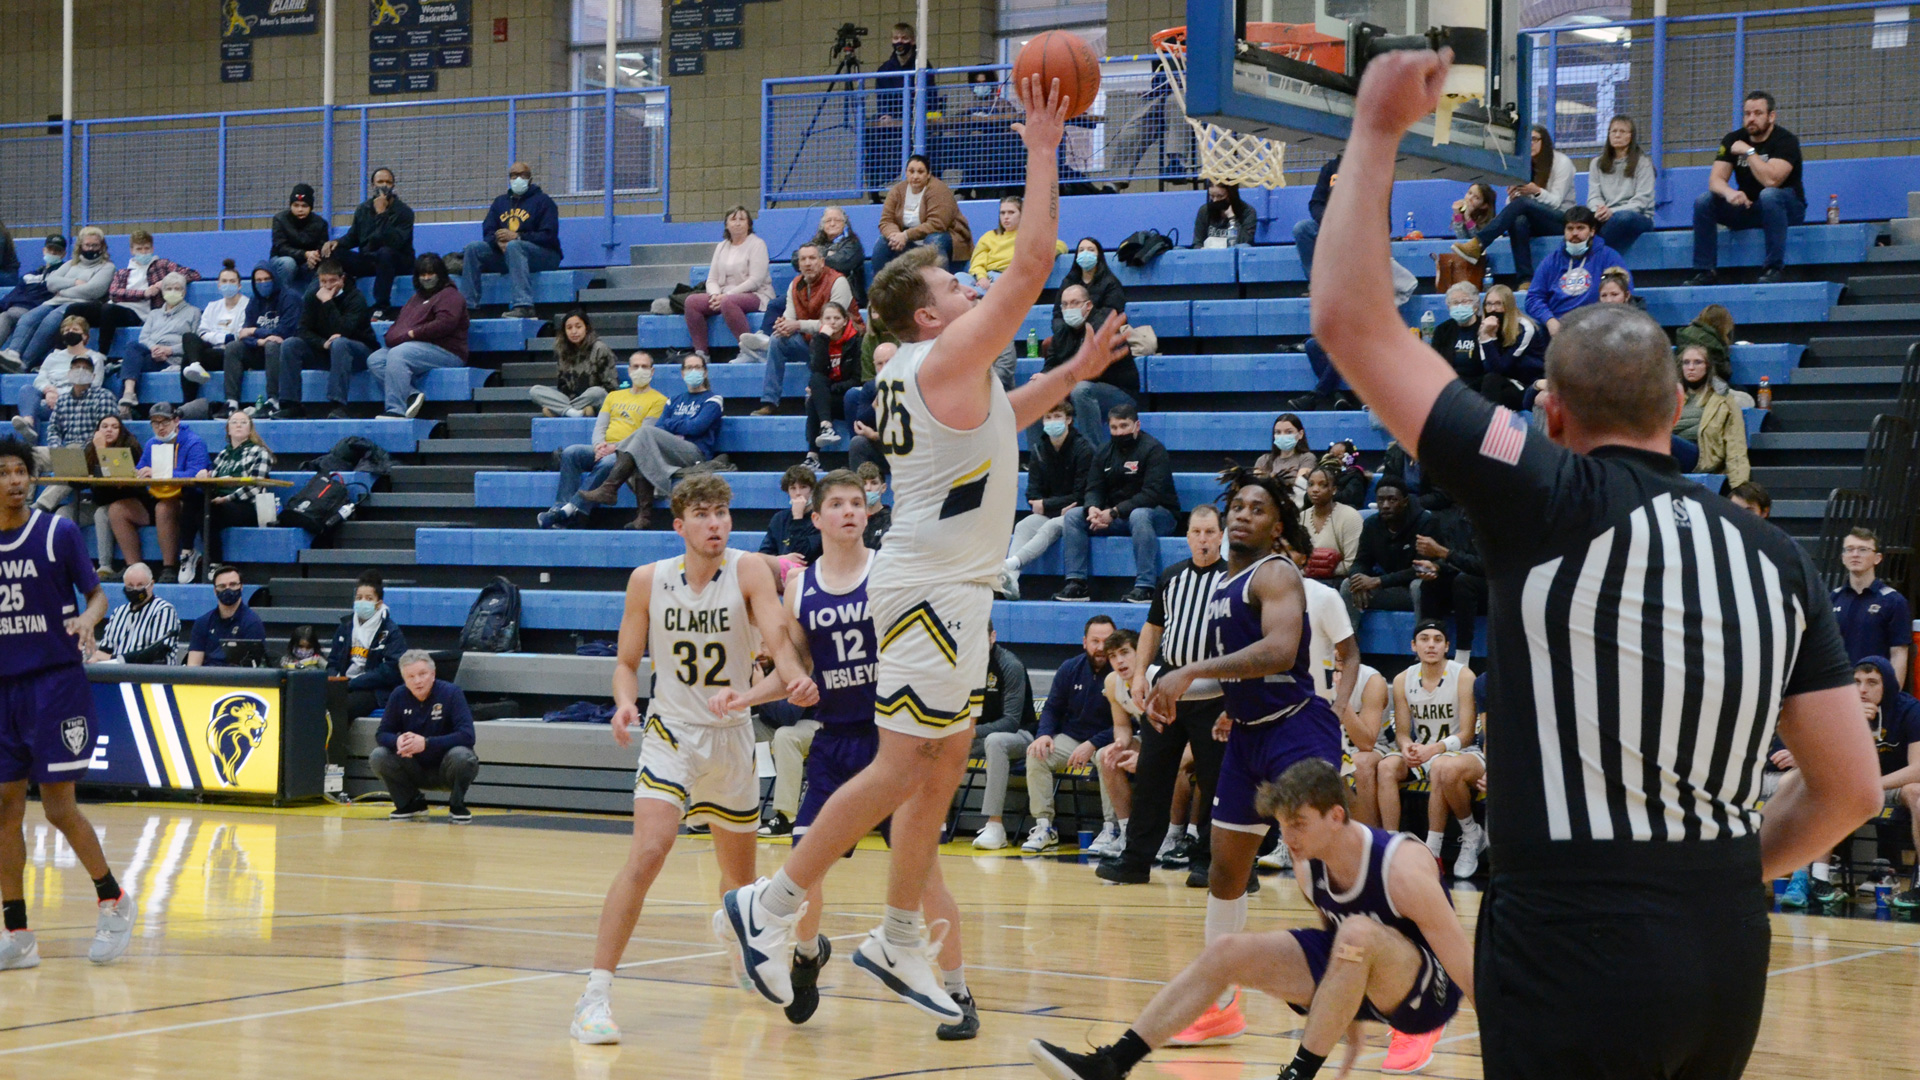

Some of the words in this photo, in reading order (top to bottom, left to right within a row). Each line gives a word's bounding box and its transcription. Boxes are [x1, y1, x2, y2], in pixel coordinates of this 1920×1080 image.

[419, 11, 458, 23] Basketball
[421, 4, 456, 13] Women's
[260, 17, 280, 27] Men's
[280, 14, 315, 24] Basketball
[499, 207, 531, 223] CLARKE
[611, 402, 645, 415] PRIDE
[877, 379, 914, 457] 25
[0, 559, 38, 579] WA
[0, 583, 25, 612] 25
[664, 607, 731, 634] CLARKE
[831, 628, 868, 662] 12
[672, 640, 731, 687] 32
[1409, 703, 1454, 720] CLARKE
